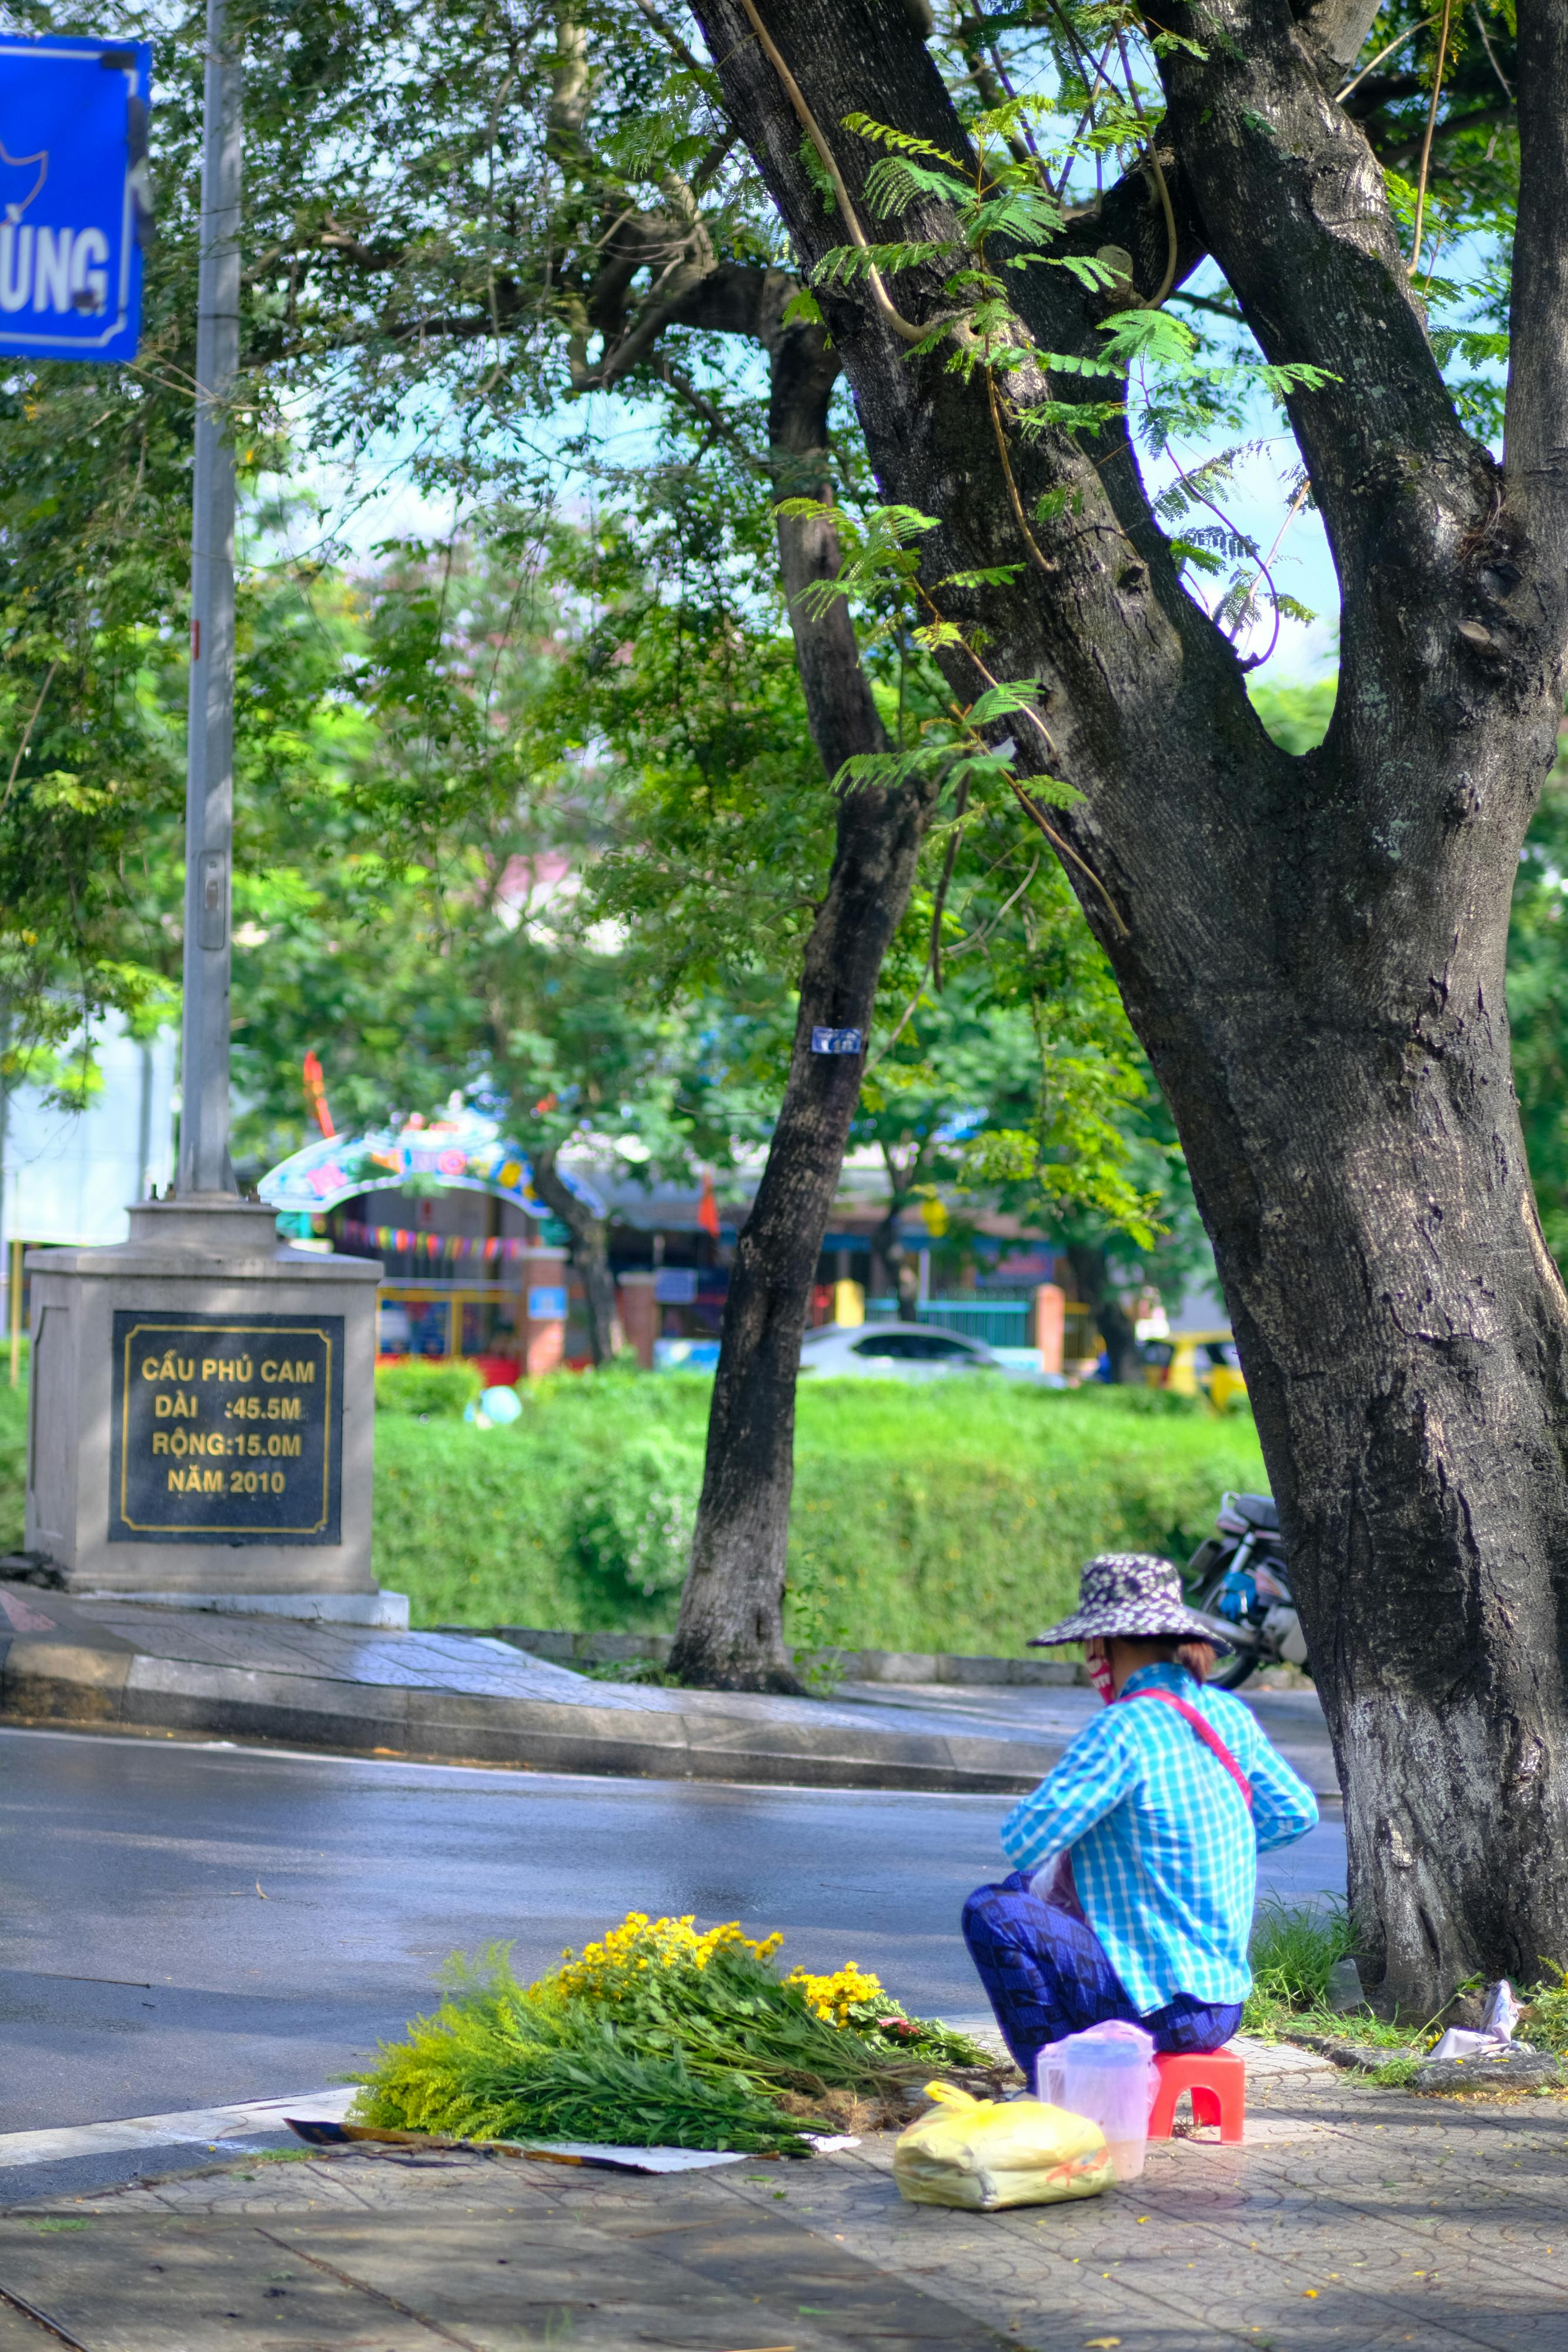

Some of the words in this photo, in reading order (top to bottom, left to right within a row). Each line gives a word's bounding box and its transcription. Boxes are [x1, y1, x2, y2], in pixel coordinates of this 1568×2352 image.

[260, 1359, 315, 1383] CAM
[168, 1464, 223, 1492] NĂM
[230, 1471, 286, 1494] 2010
